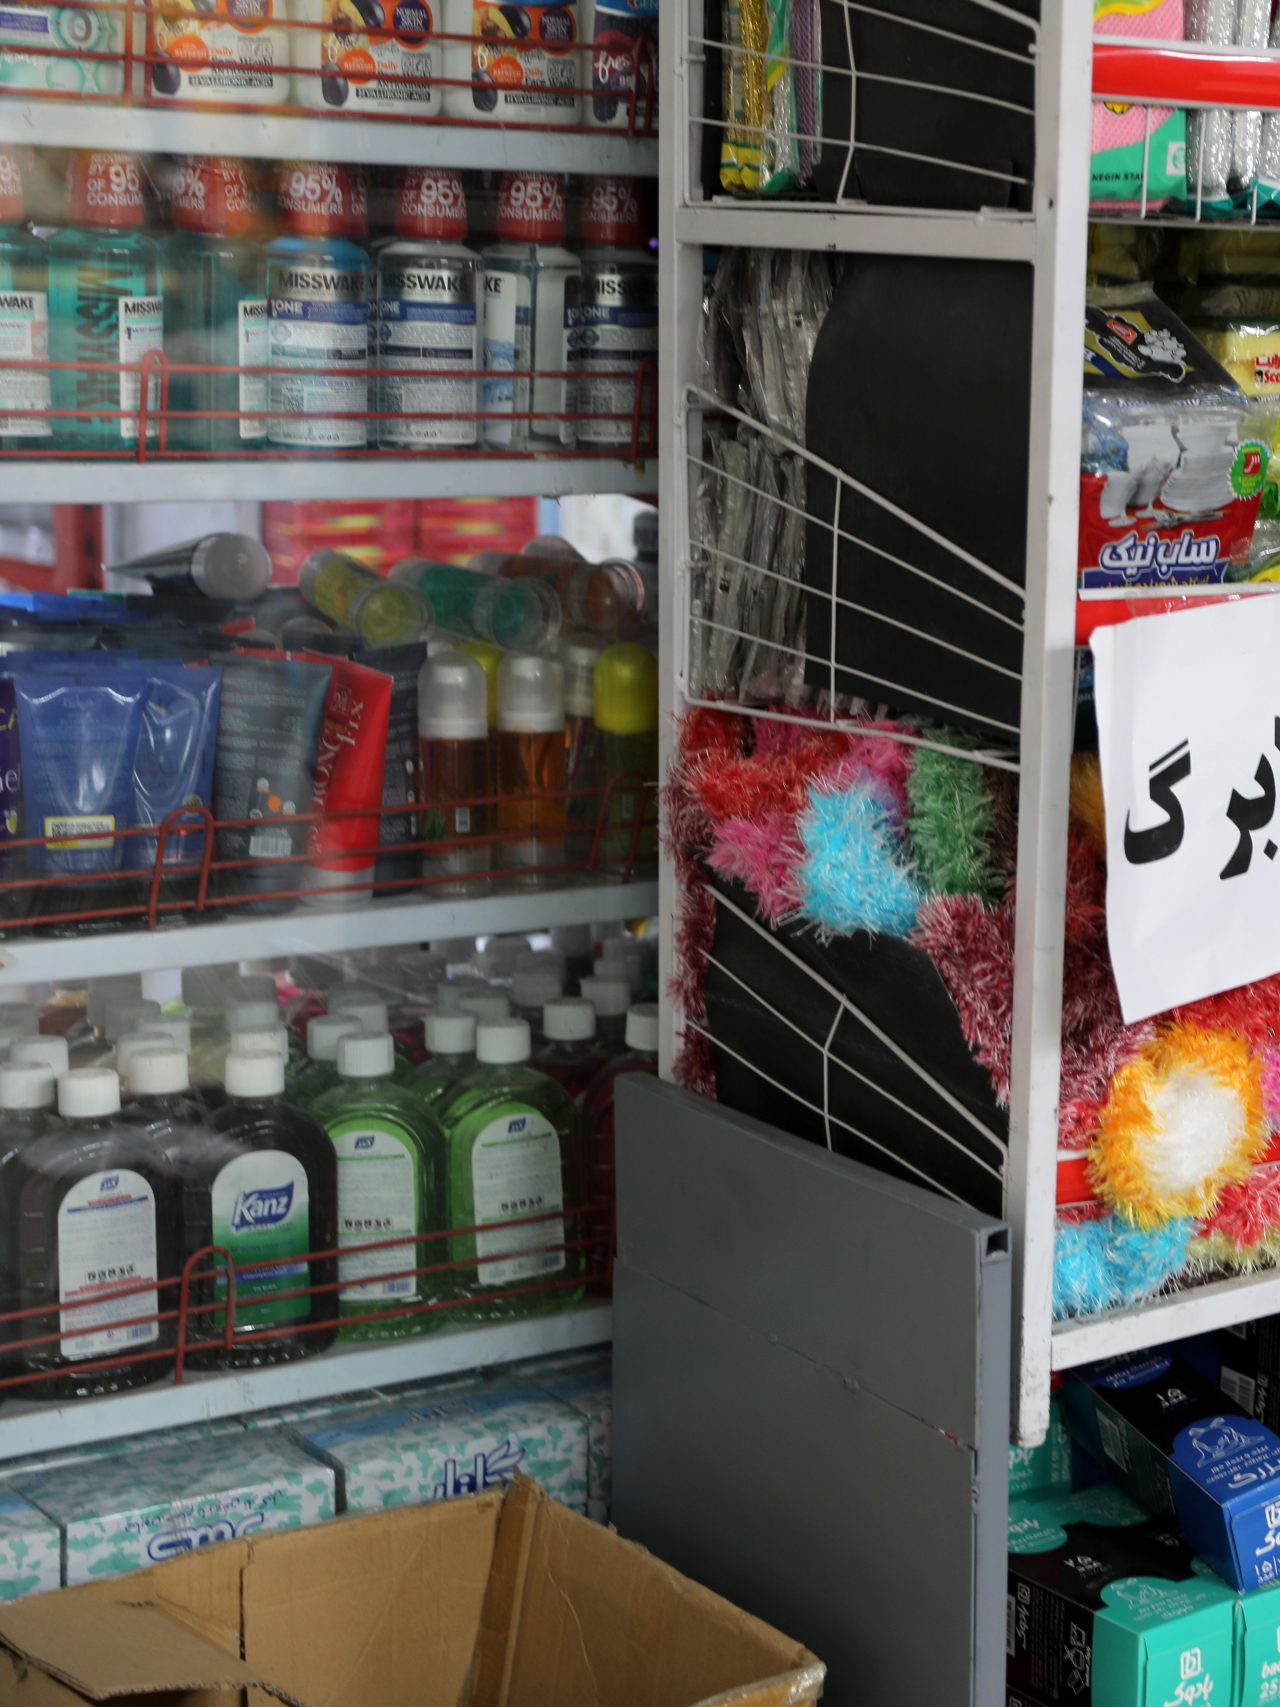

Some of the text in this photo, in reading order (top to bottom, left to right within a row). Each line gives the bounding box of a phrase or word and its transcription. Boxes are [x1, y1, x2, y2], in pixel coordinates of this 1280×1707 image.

[401, 17, 423, 28] SKIN
[289, 171, 342, 207] 95%
[511, 180, 563, 210] 95%
[1100, 532, 1219, 575] ساب نیک
[233, 1189, 289, 1224] Kanz
[1259, 1680, 1278, 1699] 25
